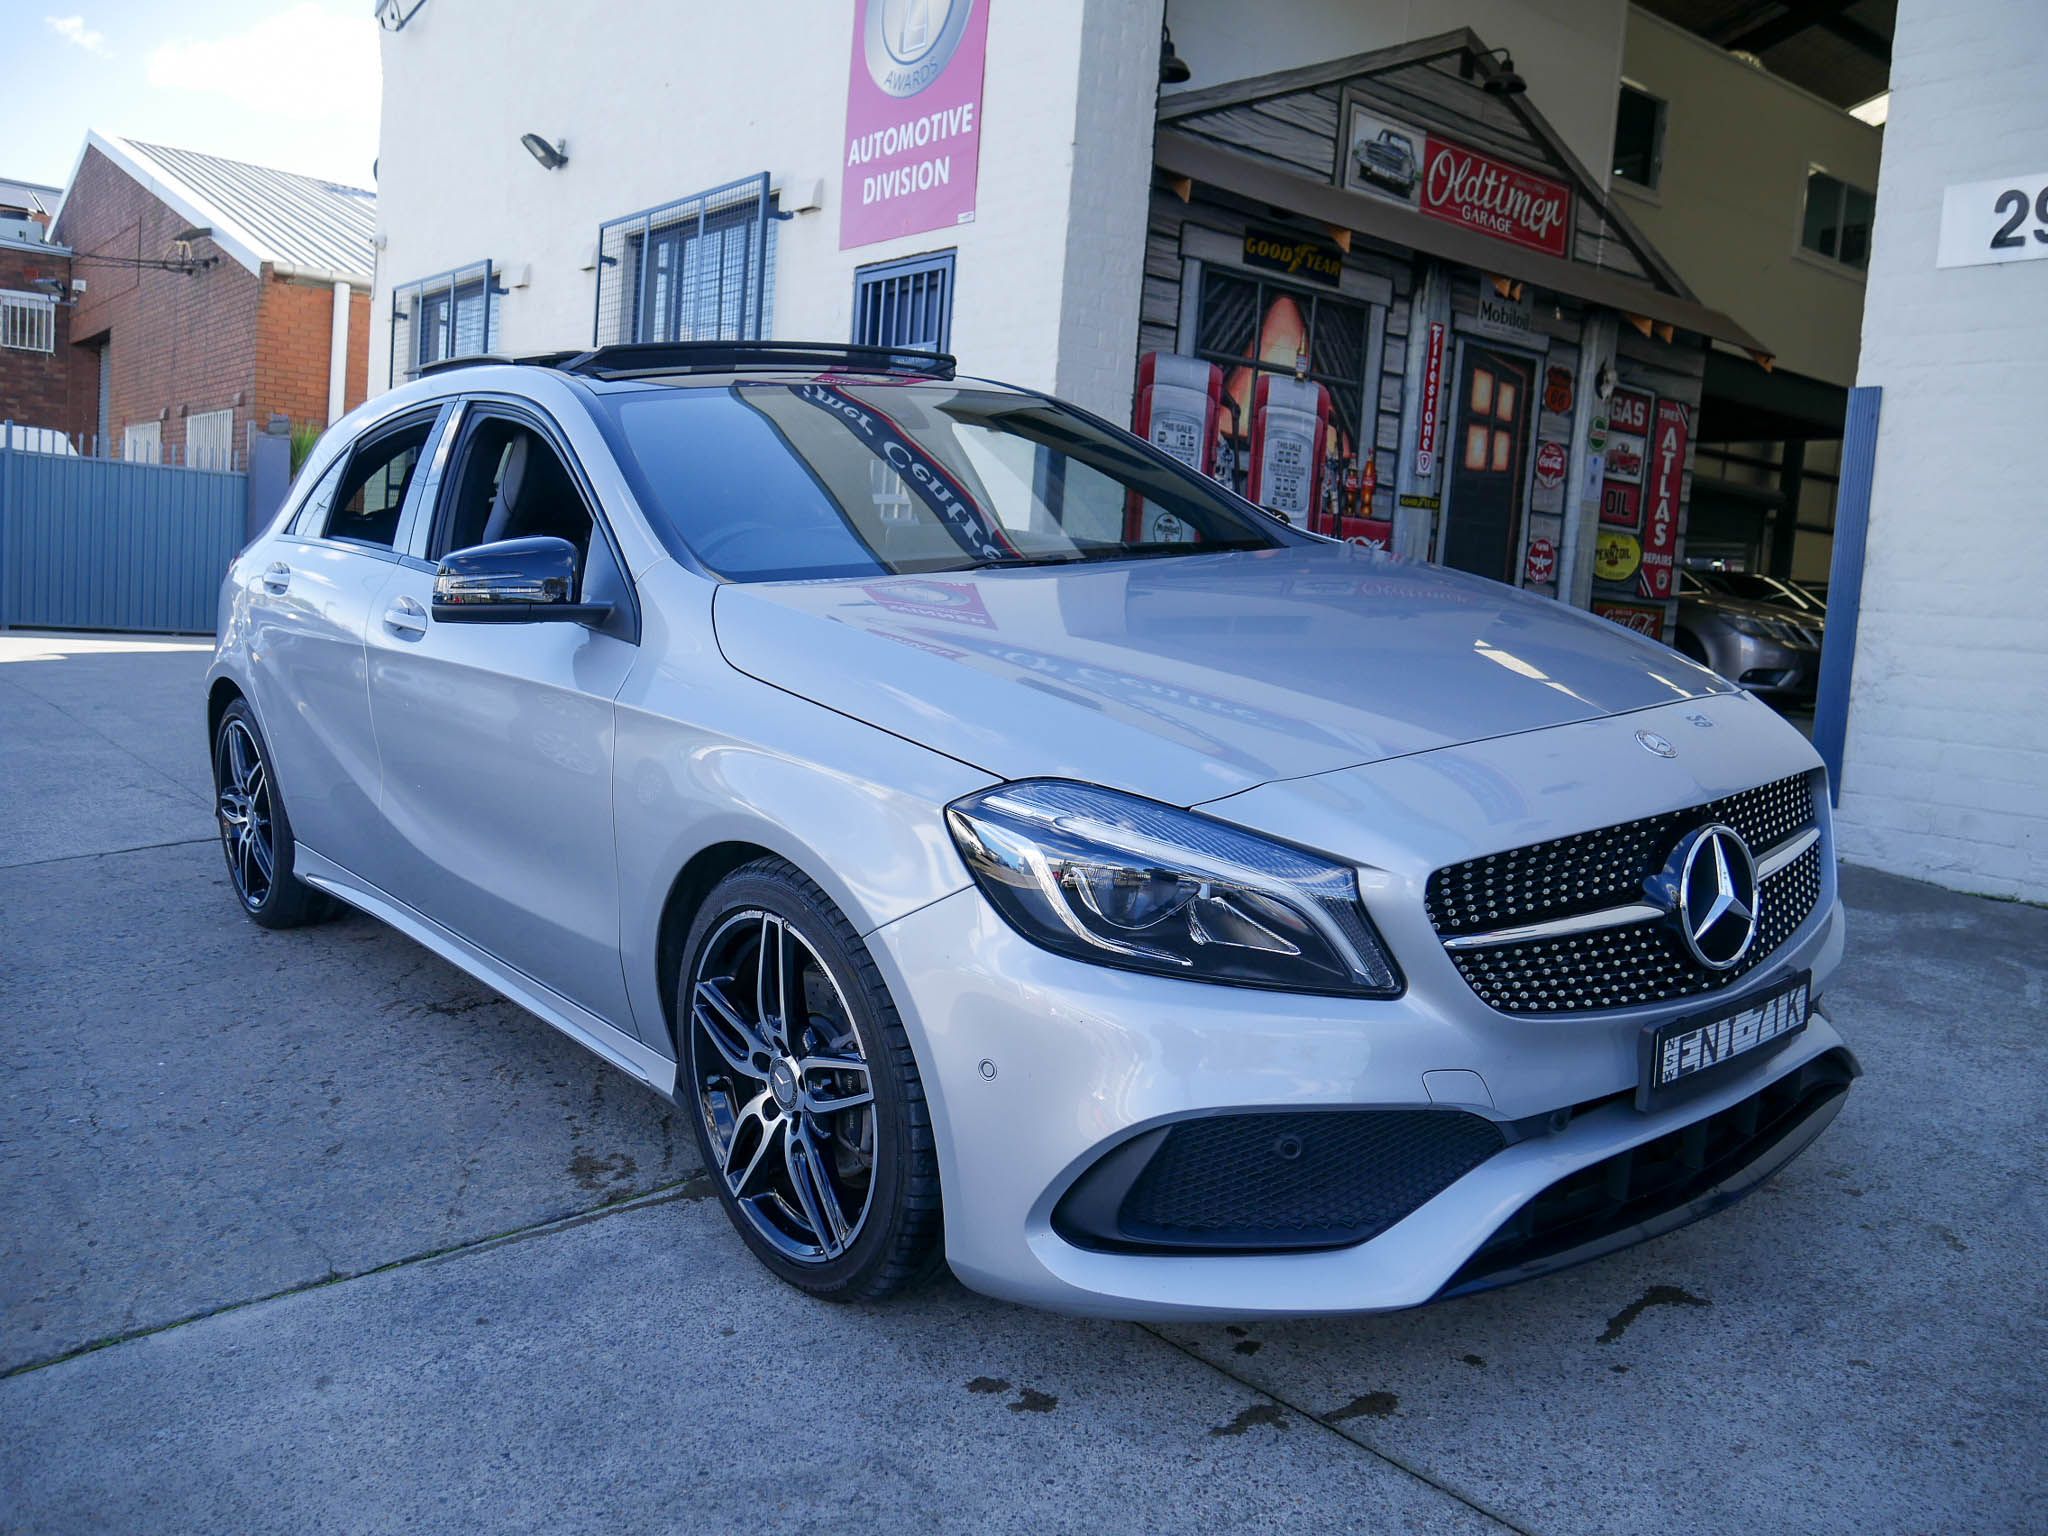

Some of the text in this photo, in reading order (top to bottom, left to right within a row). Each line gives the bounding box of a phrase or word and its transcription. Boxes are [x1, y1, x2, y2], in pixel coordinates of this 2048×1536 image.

[885, 57, 938, 91] AWARDS
[847, 103, 974, 167] AUTOMOTIVE
[863, 156, 950, 205] DIVISION
[1427, 149, 1563, 240] Oldtimer
[1461, 205, 1513, 234] GARAGE
[1611, 396, 1645, 427] GAS
[1606, 489, 1630, 516] OIL
[1654, 427, 1678, 547] ATLAS
[1643, 552, 1673, 566] REPAIRS
